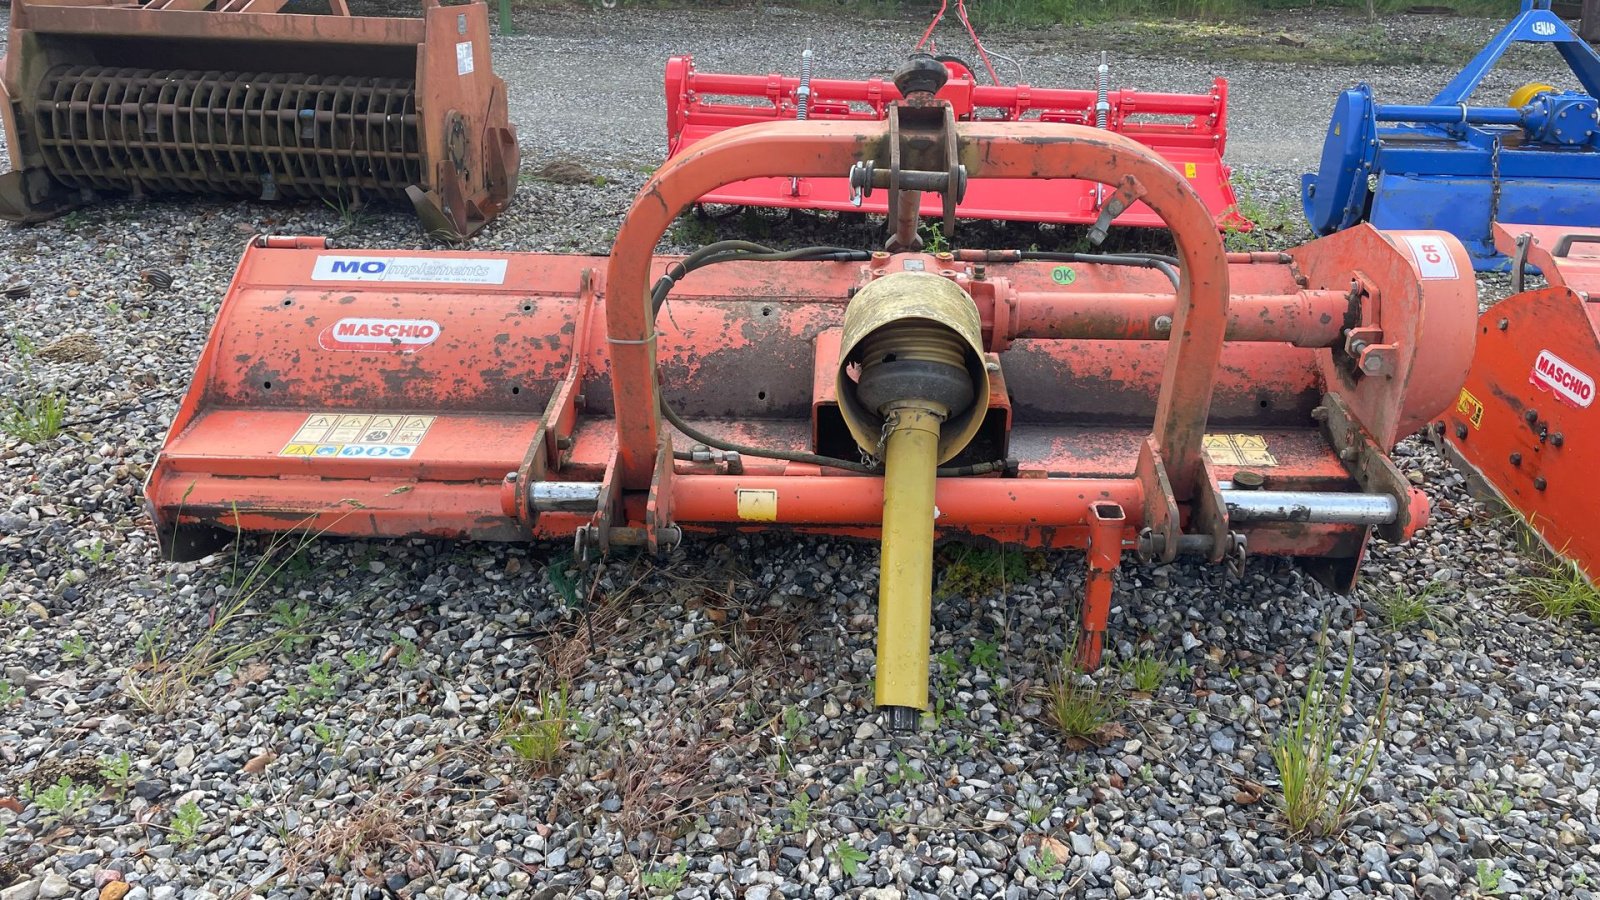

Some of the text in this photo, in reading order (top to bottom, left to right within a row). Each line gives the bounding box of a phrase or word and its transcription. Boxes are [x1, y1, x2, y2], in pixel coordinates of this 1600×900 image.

[1532, 21, 1556, 36] LENAR
[1421, 244, 1441, 263] CR
[331, 261, 386, 273] MO
[1053, 269, 1073, 281] OK
[337, 323, 434, 338] MASCHIO
[1538, 356, 1591, 400] MASCHIO
